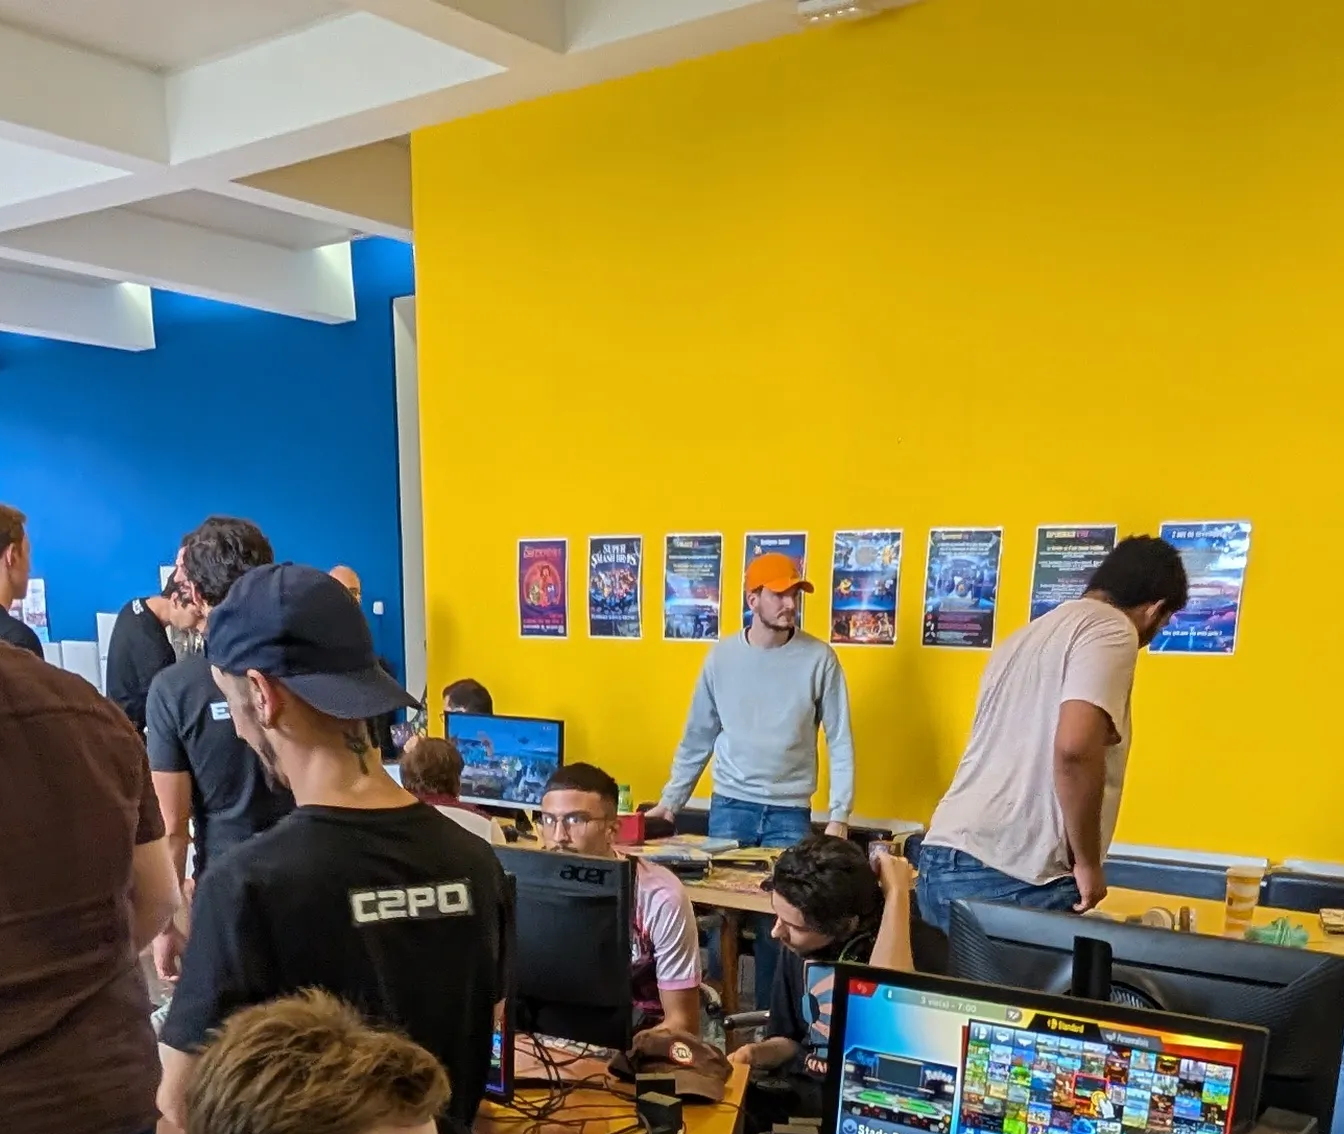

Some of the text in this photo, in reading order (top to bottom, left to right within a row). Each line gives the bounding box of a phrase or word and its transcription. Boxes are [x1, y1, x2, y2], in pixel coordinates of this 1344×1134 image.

[602, 543, 627, 554] SUPER
[591, 551, 615, 568] SMASH
[560, 864, 613, 885] acer
[352, 883, 469, 923] C2PO
